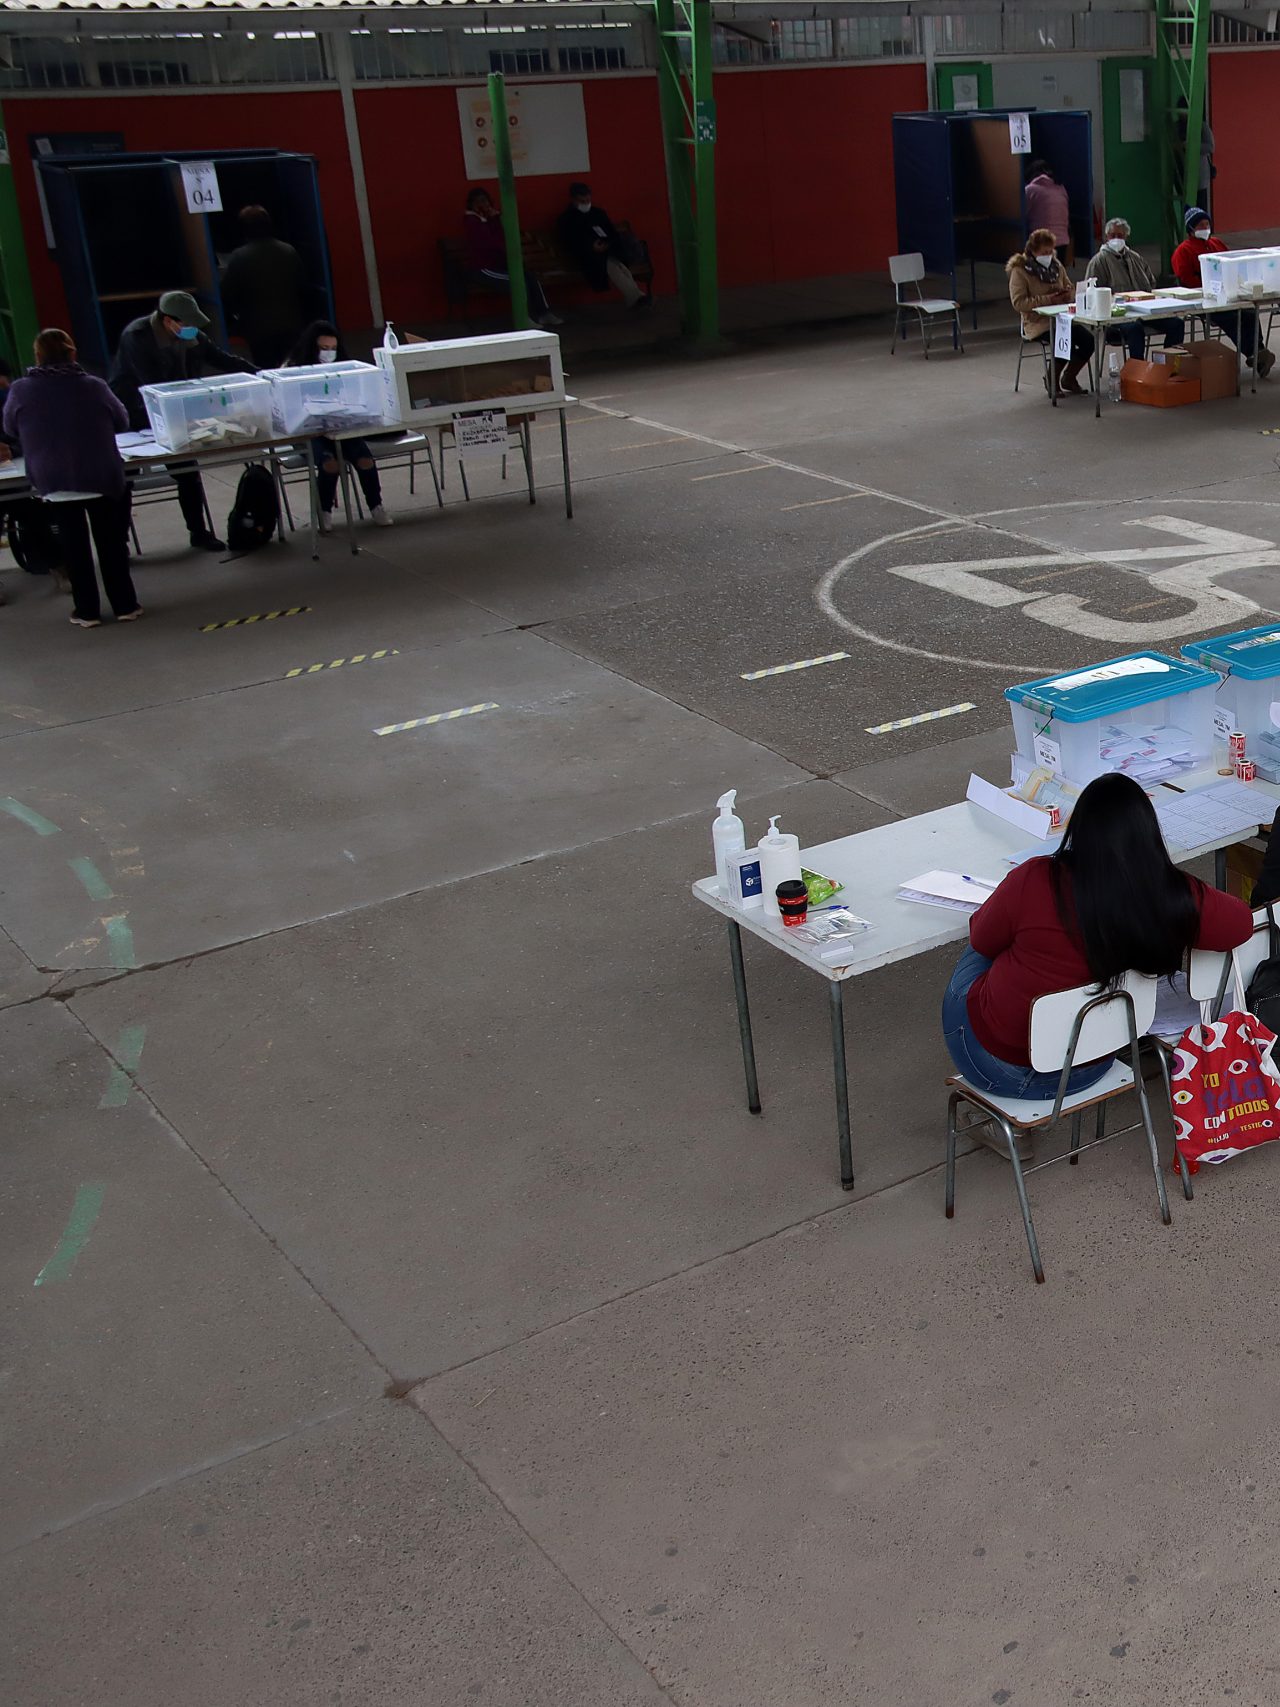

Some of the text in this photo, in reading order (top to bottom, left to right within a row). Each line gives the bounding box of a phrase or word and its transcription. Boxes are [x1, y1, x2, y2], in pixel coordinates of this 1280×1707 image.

[1013, 135, 1026, 148] 05
[193, 190, 214, 205] 04
[1058, 337, 1068, 352] 05
[1201, 1073, 1219, 1088] YO
[1227, 1099, 1269, 1120] TODOS
